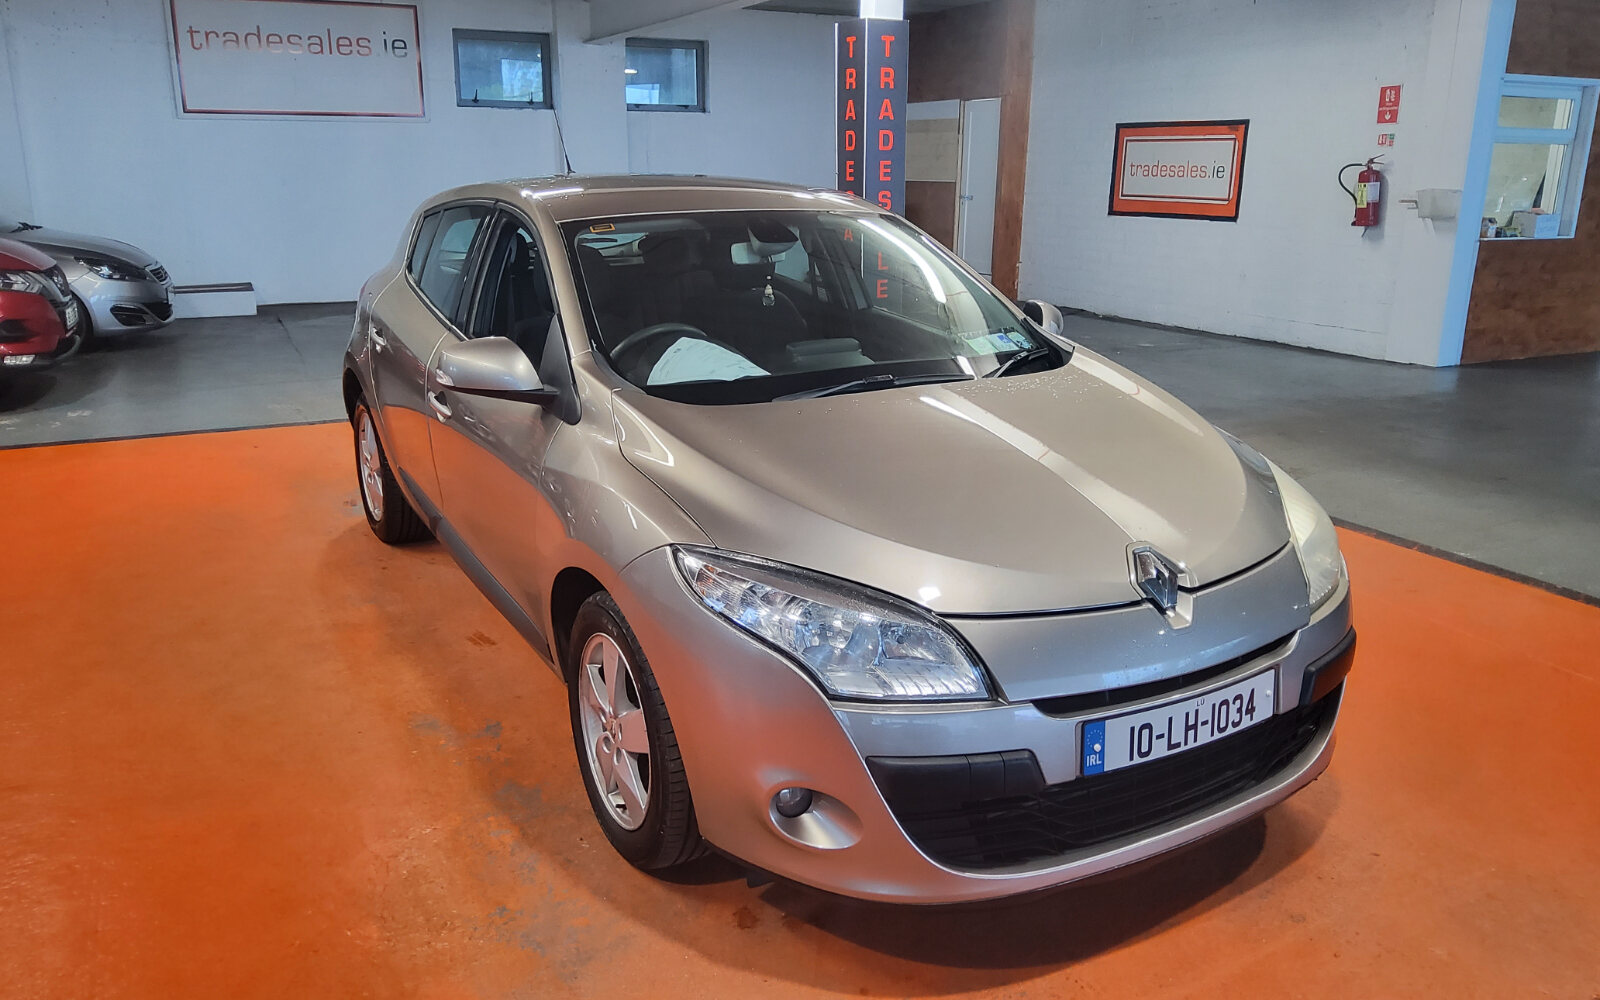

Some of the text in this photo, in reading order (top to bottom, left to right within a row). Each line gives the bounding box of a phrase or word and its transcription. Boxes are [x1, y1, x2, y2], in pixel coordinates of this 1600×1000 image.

[1129, 159, 1226, 179] tradesales.ie
[1128, 687, 1257, 762] 10-LH-1034
[1086, 754, 1103, 768] IRL
